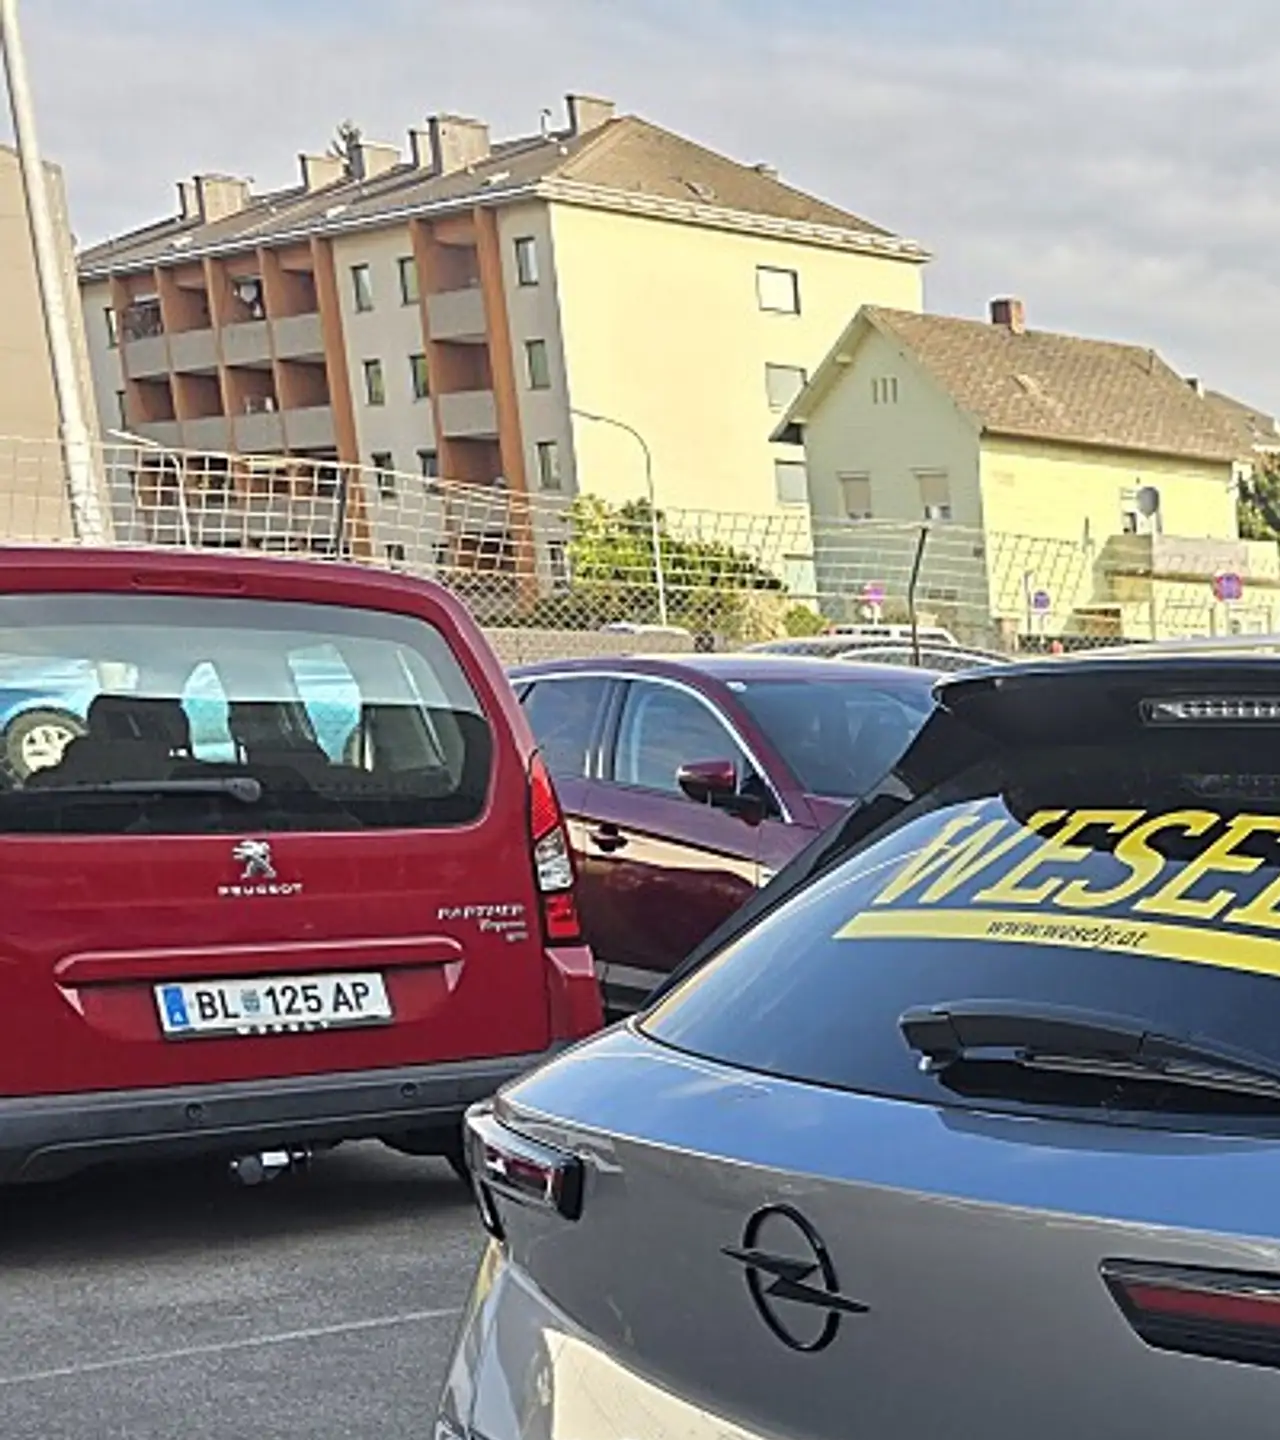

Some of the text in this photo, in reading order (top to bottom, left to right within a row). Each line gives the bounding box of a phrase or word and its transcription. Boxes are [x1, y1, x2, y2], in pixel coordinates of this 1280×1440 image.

[217, 883, 303, 896] PEUGEOT
[437, 903, 525, 920] PARTNER
[986, 921, 1150, 948] www.wesely.at
[195, 982, 370, 1021] BL 125 AP
